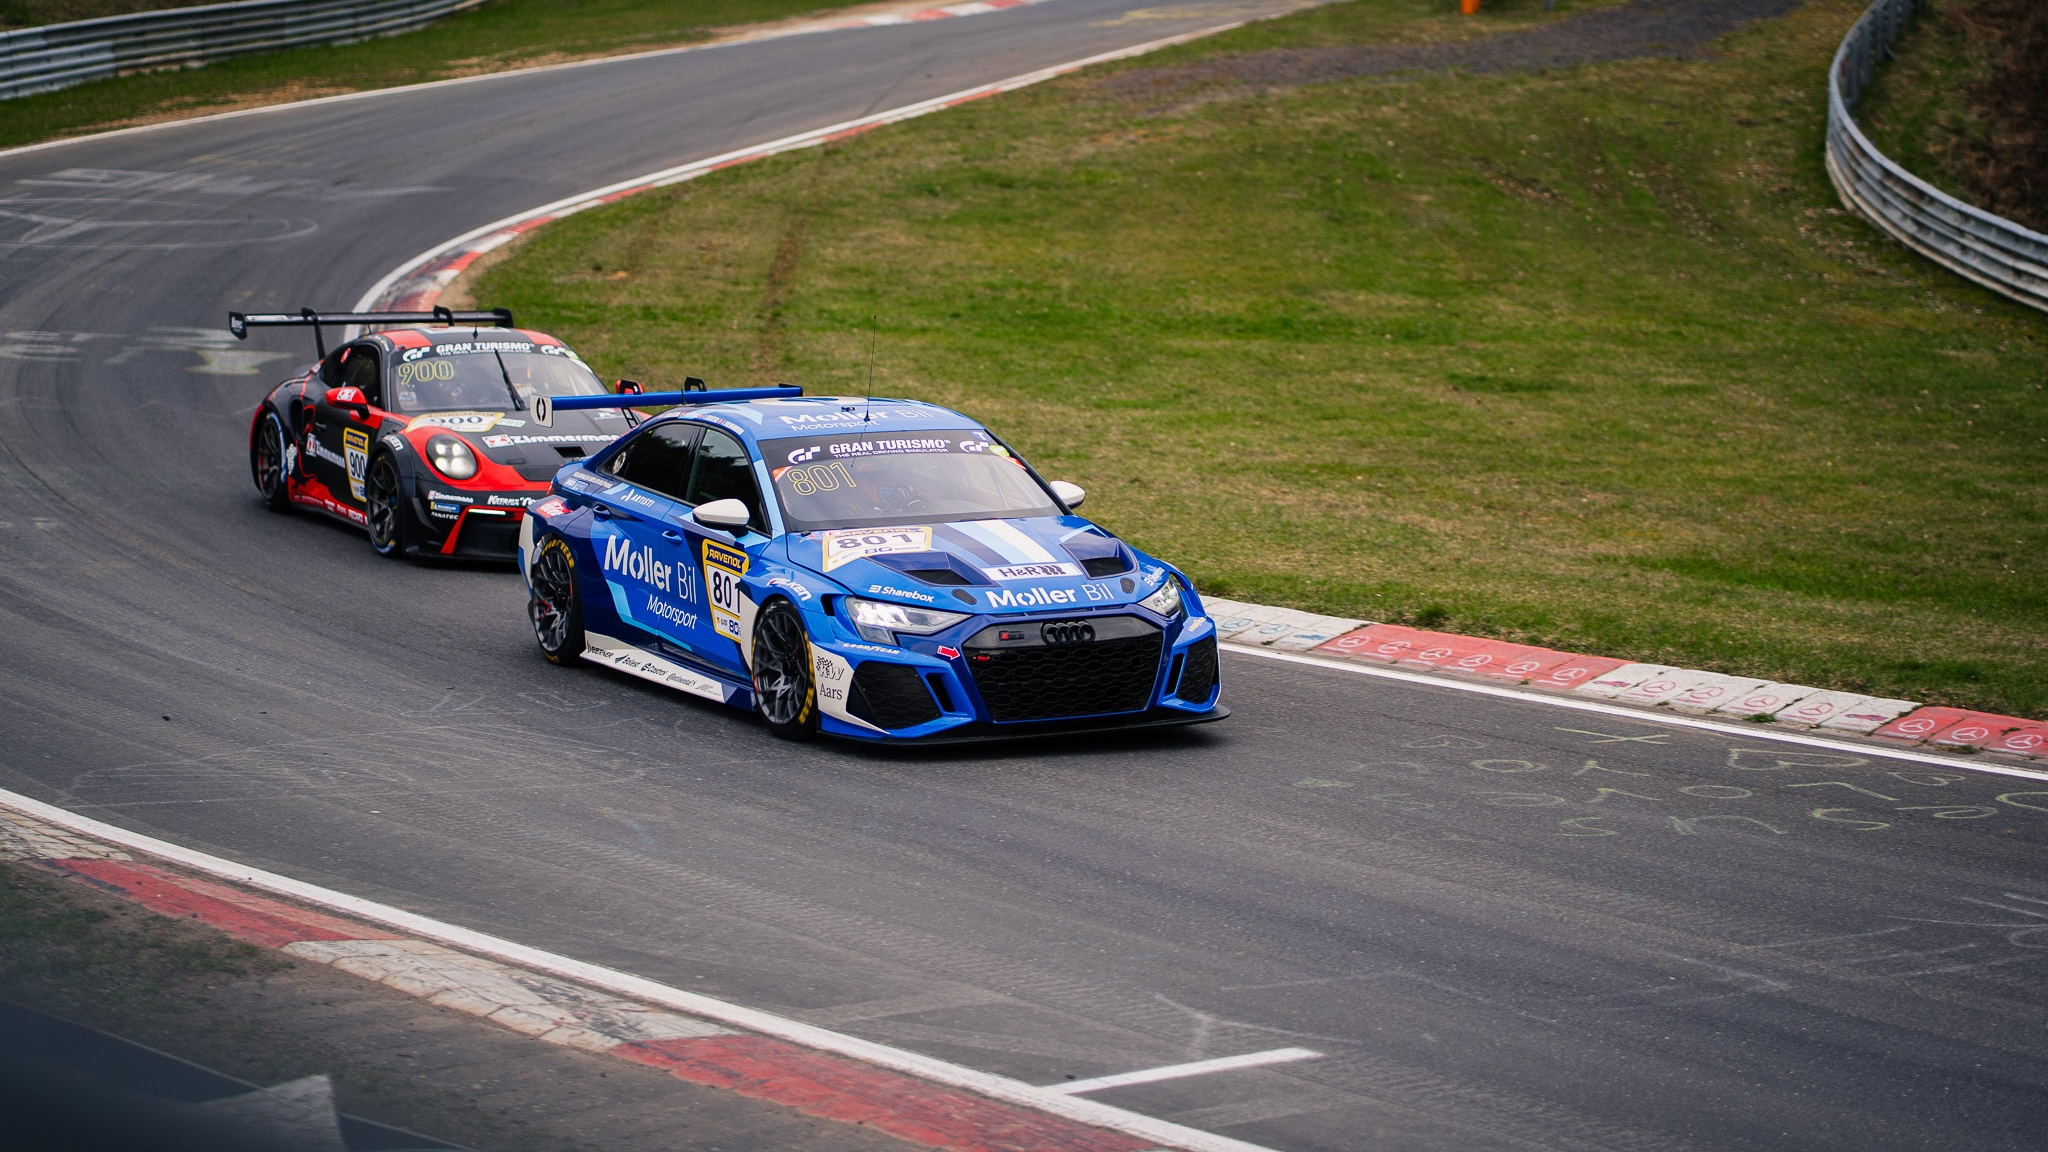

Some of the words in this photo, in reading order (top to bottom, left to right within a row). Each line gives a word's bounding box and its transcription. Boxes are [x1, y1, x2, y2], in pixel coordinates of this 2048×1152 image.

[436, 342, 472, 354] GRAN
[398, 360, 454, 386] 900
[894, 409, 934, 418] Bil
[791, 420, 879, 431] Motorsport
[829, 442, 873, 455] GRAN
[349, 452, 367, 482] 900
[787, 462, 856, 496] 801
[431, 511, 459, 520] FANATEC
[837, 533, 913, 549] 801
[709, 548, 742, 569] RAVENOL
[999, 567, 1041, 577] H&R
[677, 561, 697, 604] Bil
[713, 571, 740, 614] 801
[882, 587, 934, 603] Sharebox
[1082, 583, 1115, 600] Bil
[646, 594, 697, 629] Motorsport
[843, 642, 900, 655] GOODYEAR
[819, 683, 843, 701] Aars
